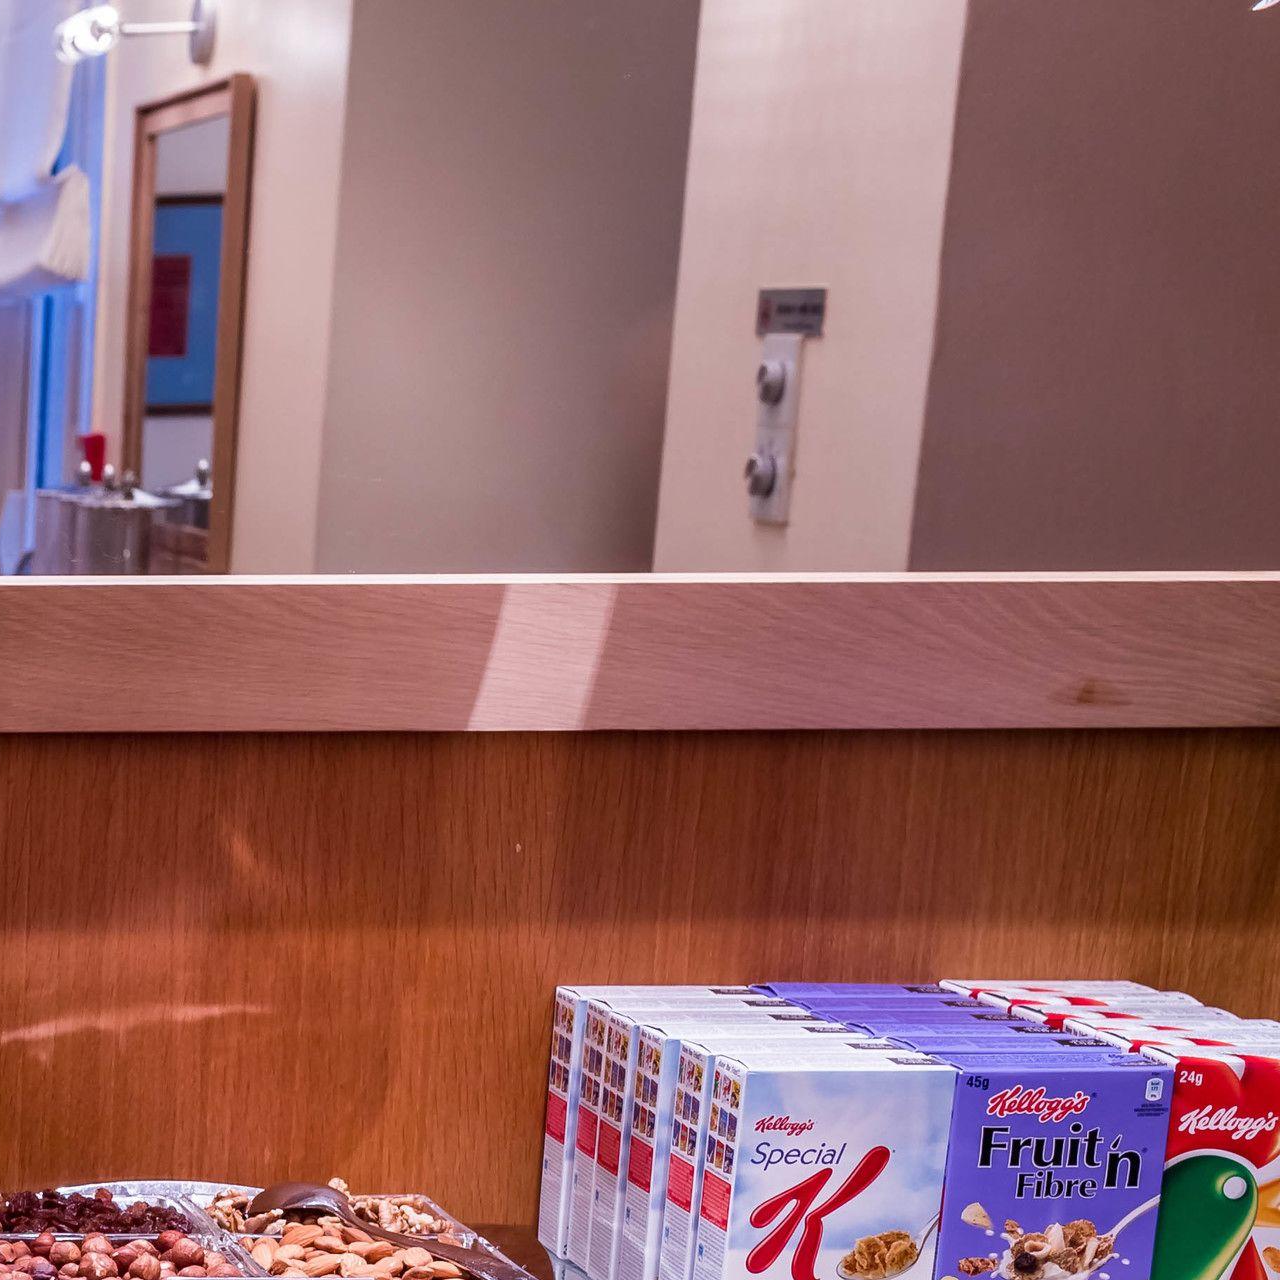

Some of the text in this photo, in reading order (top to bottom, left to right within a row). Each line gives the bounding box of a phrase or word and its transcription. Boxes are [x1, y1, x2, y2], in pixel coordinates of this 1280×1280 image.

[966, 1076, 989, 1090] 45g
[1180, 1071, 1203, 1086] 24g
[987, 1085, 1090, 1123] Kellogg's
[754, 1116, 814, 1136] Kellogg's
[1178, 1105, 1279, 1140] Kellogg's
[751, 1142, 847, 1171] Special
[978, 1122, 1104, 1169] Fruit
[1015, 1170, 1097, 1199] Fibre
